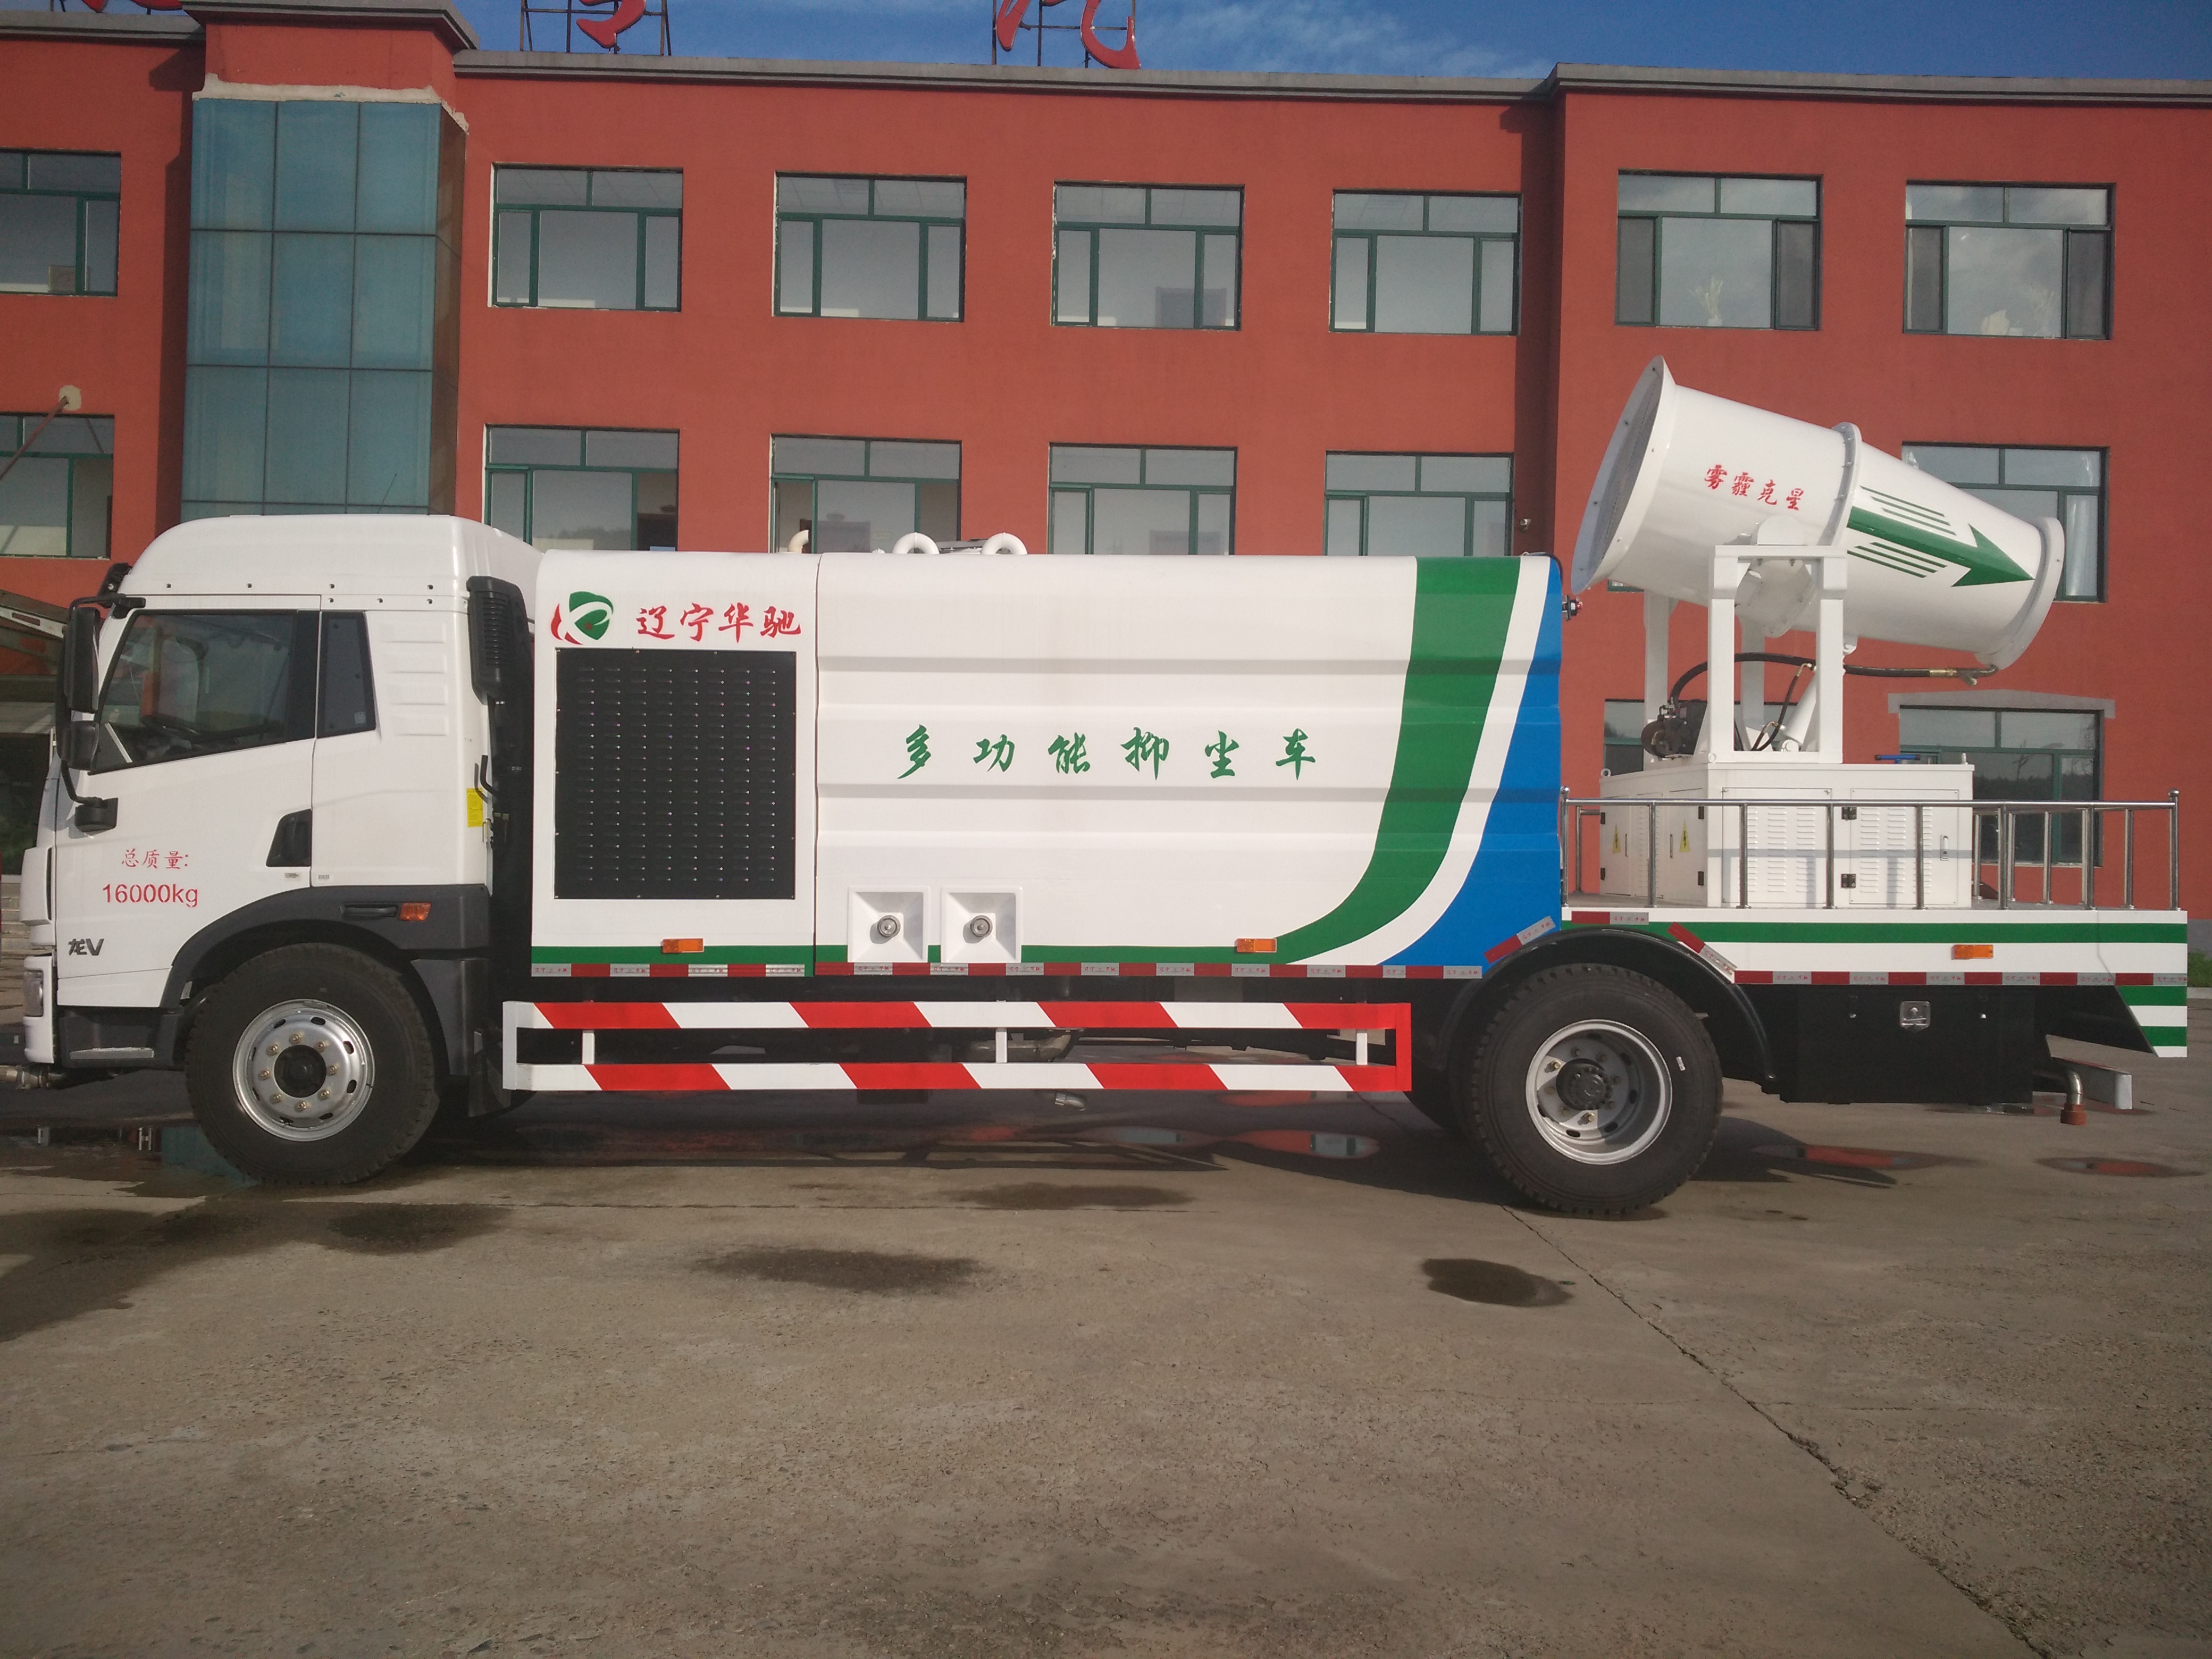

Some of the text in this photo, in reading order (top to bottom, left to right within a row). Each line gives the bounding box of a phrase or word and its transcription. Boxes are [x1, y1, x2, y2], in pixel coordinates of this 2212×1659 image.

[1704, 464, 1804, 511] 雾霾克星
[635, 601, 802, 643] 辽宁华驰
[898, 724, 1316, 780] 多功能抑尘车
[103, 883, 198, 908] 16000kg
